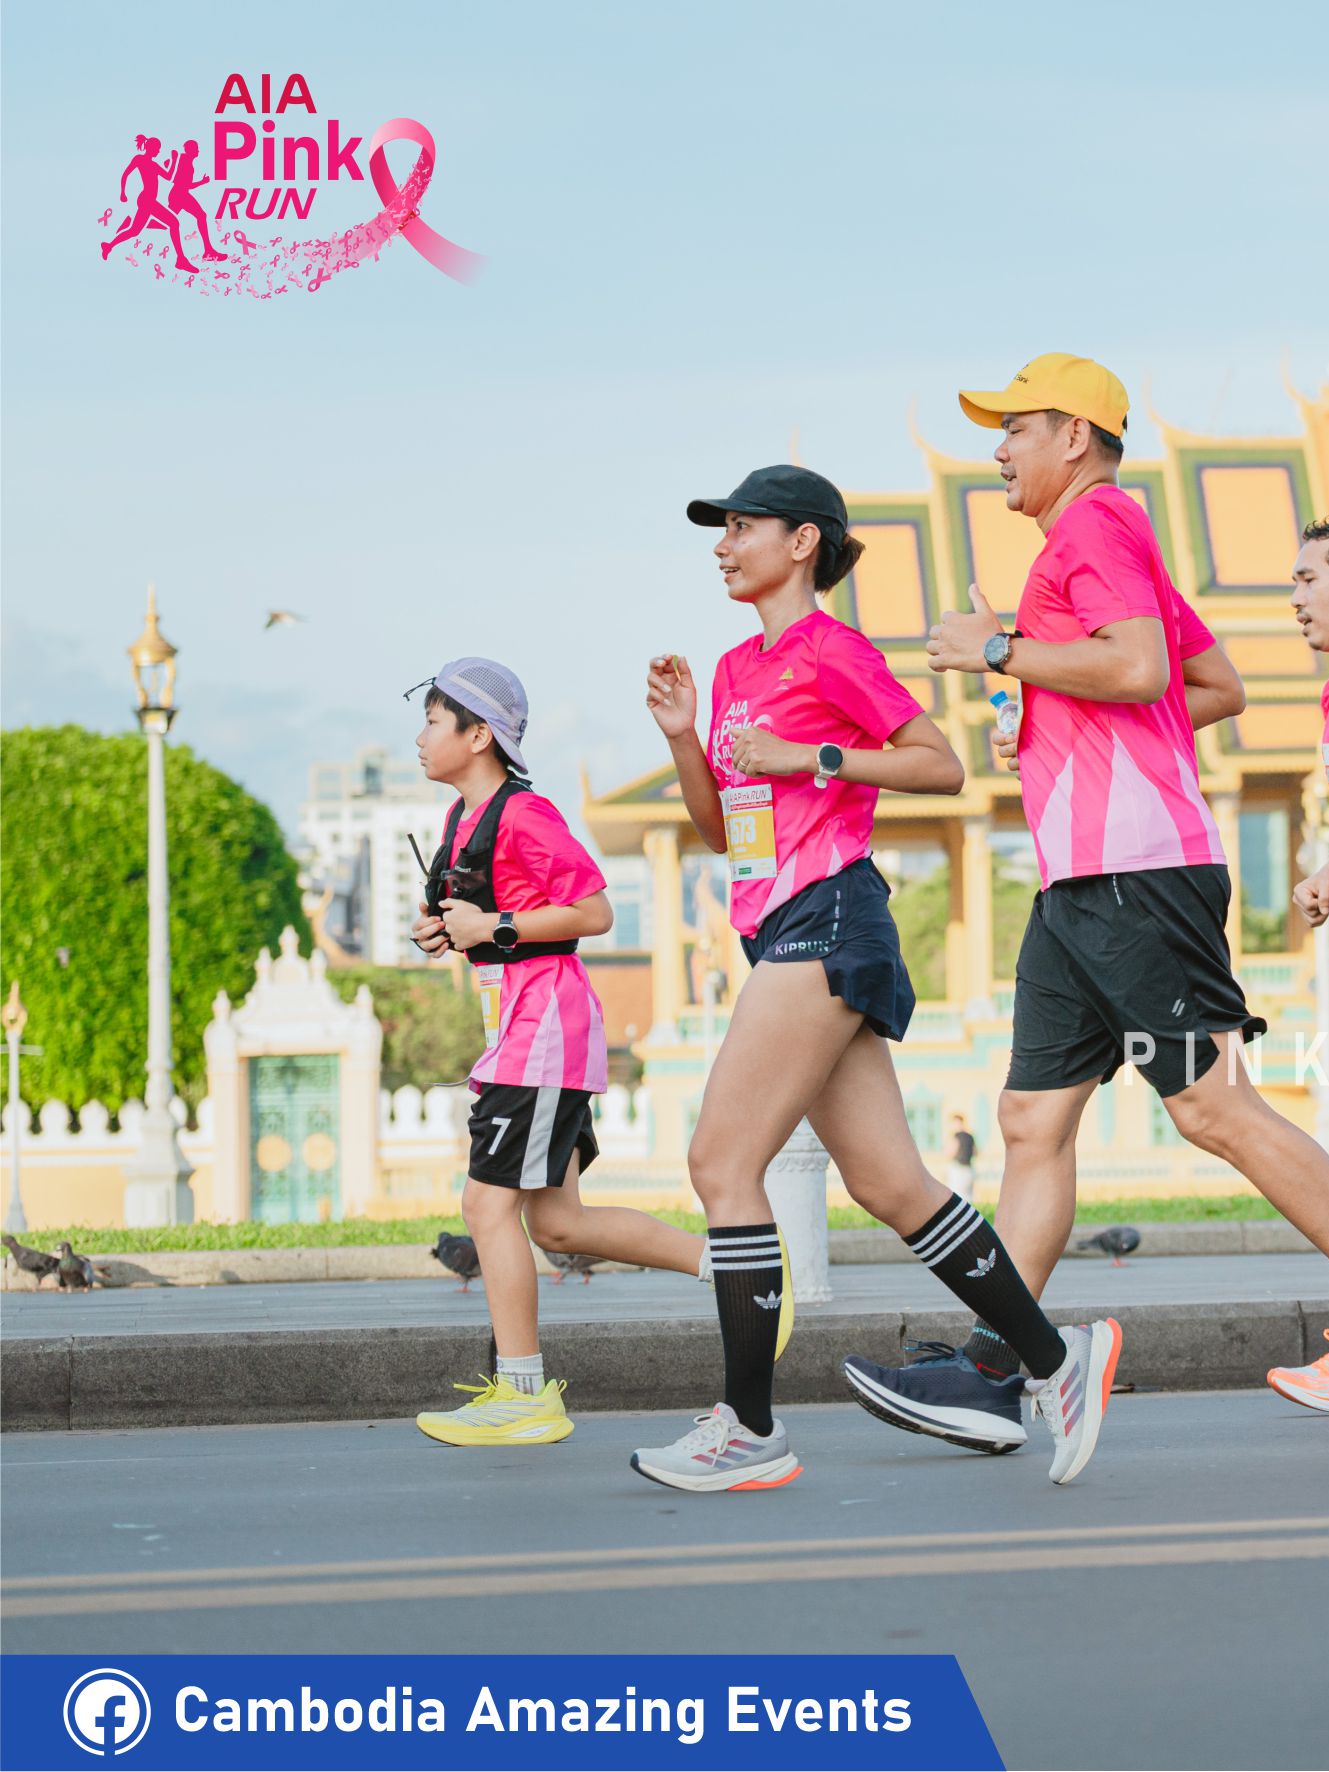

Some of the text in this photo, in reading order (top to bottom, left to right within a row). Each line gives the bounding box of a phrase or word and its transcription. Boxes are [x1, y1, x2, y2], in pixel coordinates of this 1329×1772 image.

[725, 700, 748, 718] AIA
[775, 940, 829, 955] KIPRUN
[488, 1117, 512, 1155] 7
